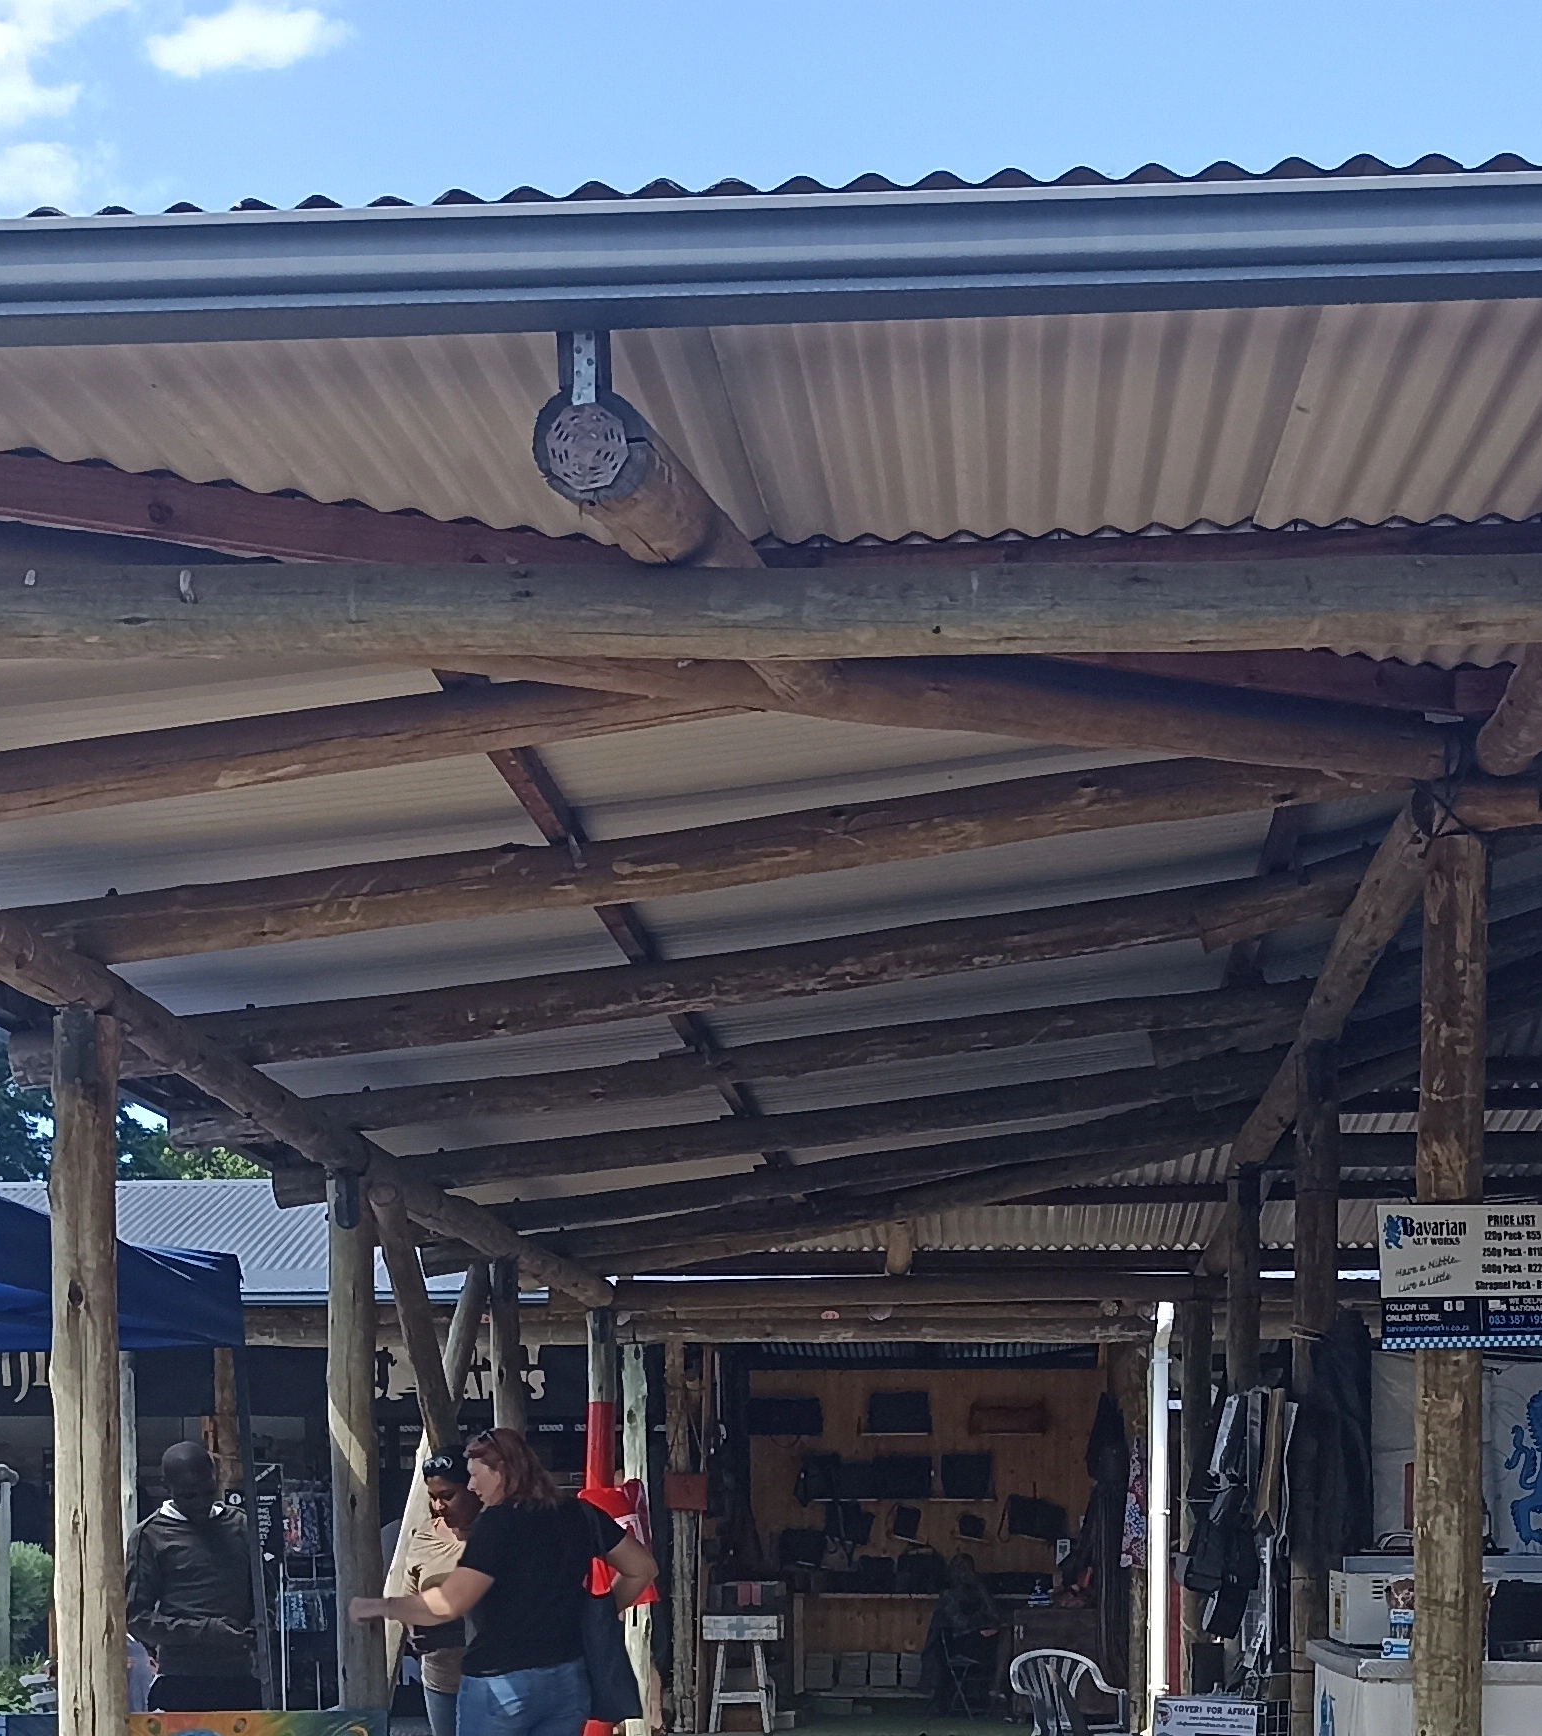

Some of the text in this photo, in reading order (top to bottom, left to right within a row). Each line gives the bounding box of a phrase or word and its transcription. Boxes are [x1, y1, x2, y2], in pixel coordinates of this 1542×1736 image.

[1487, 1215, 1535, 1226] PRICE LIST
[1400, 1216, 1467, 1237] Bavarian
[1489, 1315, 1506, 1324] 083
[1207, 1706, 1223, 1715] FOR
[1227, 1707, 1255, 1717] AFRICA
